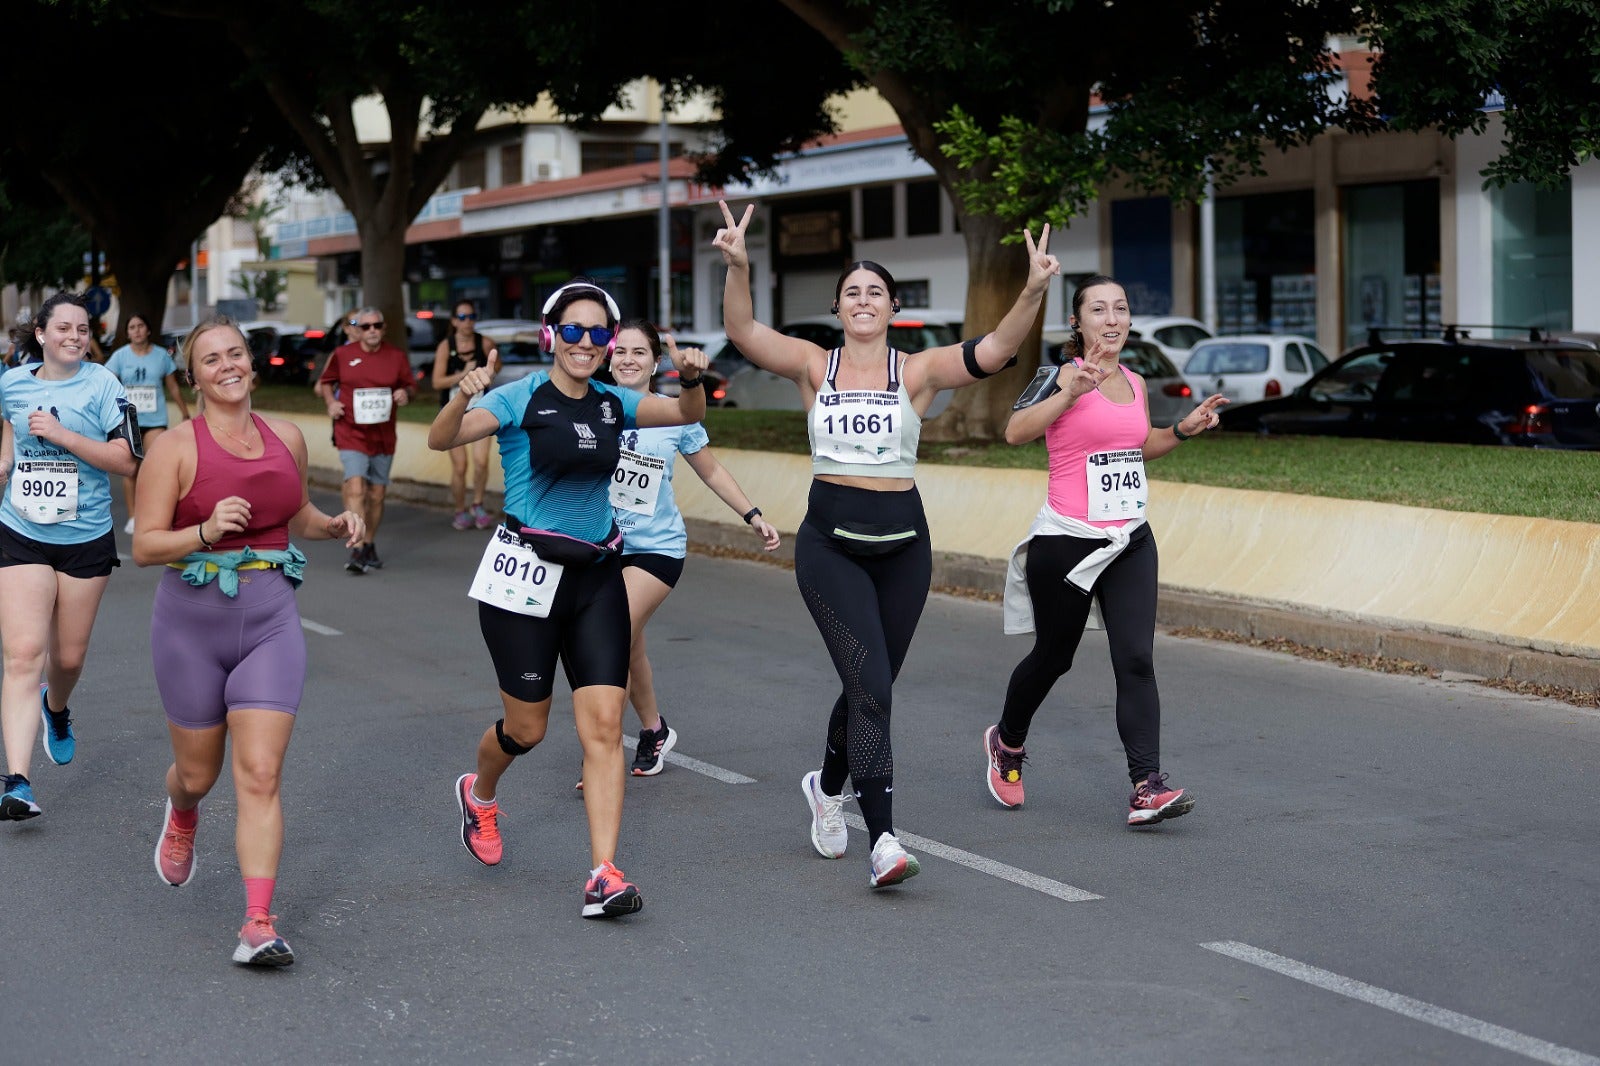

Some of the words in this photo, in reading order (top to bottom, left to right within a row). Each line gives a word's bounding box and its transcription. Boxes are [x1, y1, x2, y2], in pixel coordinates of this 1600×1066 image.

[820, 394, 840, 407] 43
[824, 413, 893, 435] 11661
[17, 461, 32, 473] 43
[1089, 453, 1109, 466] 43
[614, 467, 650, 489] 070
[1101, 470, 1141, 493] 9748
[22, 480, 67, 498] 9902
[493, 552, 547, 586] 6010
